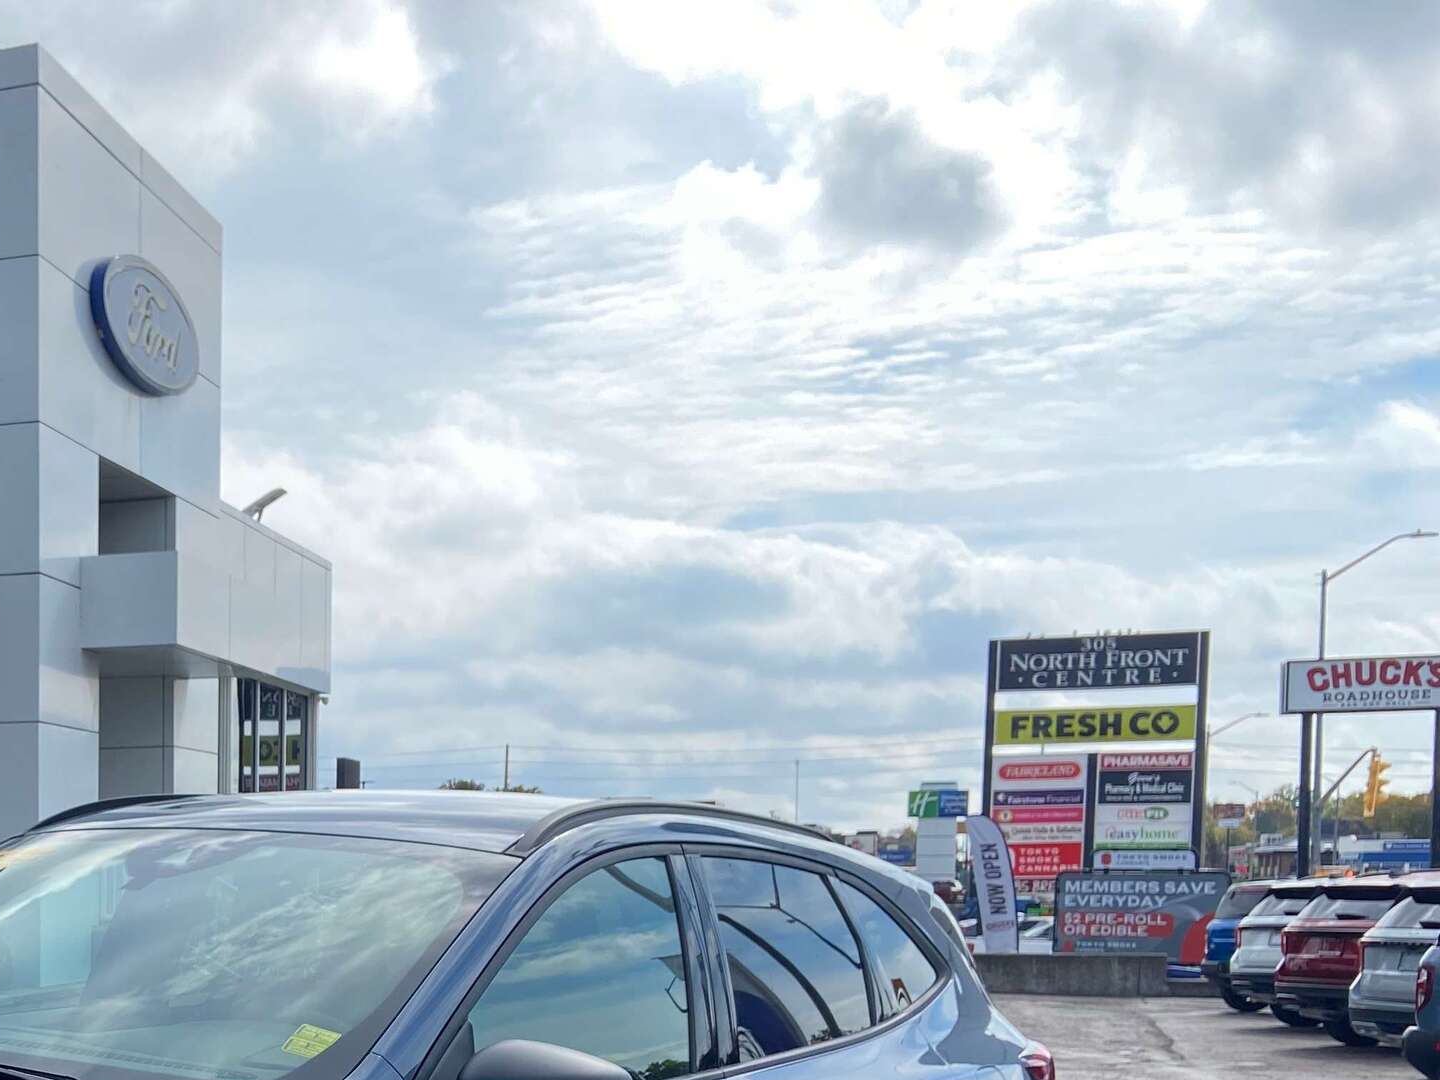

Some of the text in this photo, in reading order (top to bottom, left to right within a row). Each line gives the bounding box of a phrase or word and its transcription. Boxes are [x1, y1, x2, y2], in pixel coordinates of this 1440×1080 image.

[127, 282, 183, 376] Ford
[1081, 638, 1117, 652] 305
[1010, 648, 1189, 672] NORTH FRONT
[1032, 667, 1161, 687] CENTRE
[1323, 689, 1431, 703] ROADHOUSE
[1103, 754, 1190, 768] PHARMASAVE
[1019, 846, 1060, 855] TOKYO
[980, 843, 1002, 880] OPEN
[1019, 855, 1061, 864] SMOKE
[1064, 880, 1160, 894] MEMBERS
[1164, 881, 1217, 895] SAVE
[987, 883, 1008, 915] NOW
[1064, 894, 1166, 908] EVERYDAY
[1084, 911, 1167, 927] PRE-ROLL
[1063, 924, 1148, 937] OR EDIBLE
